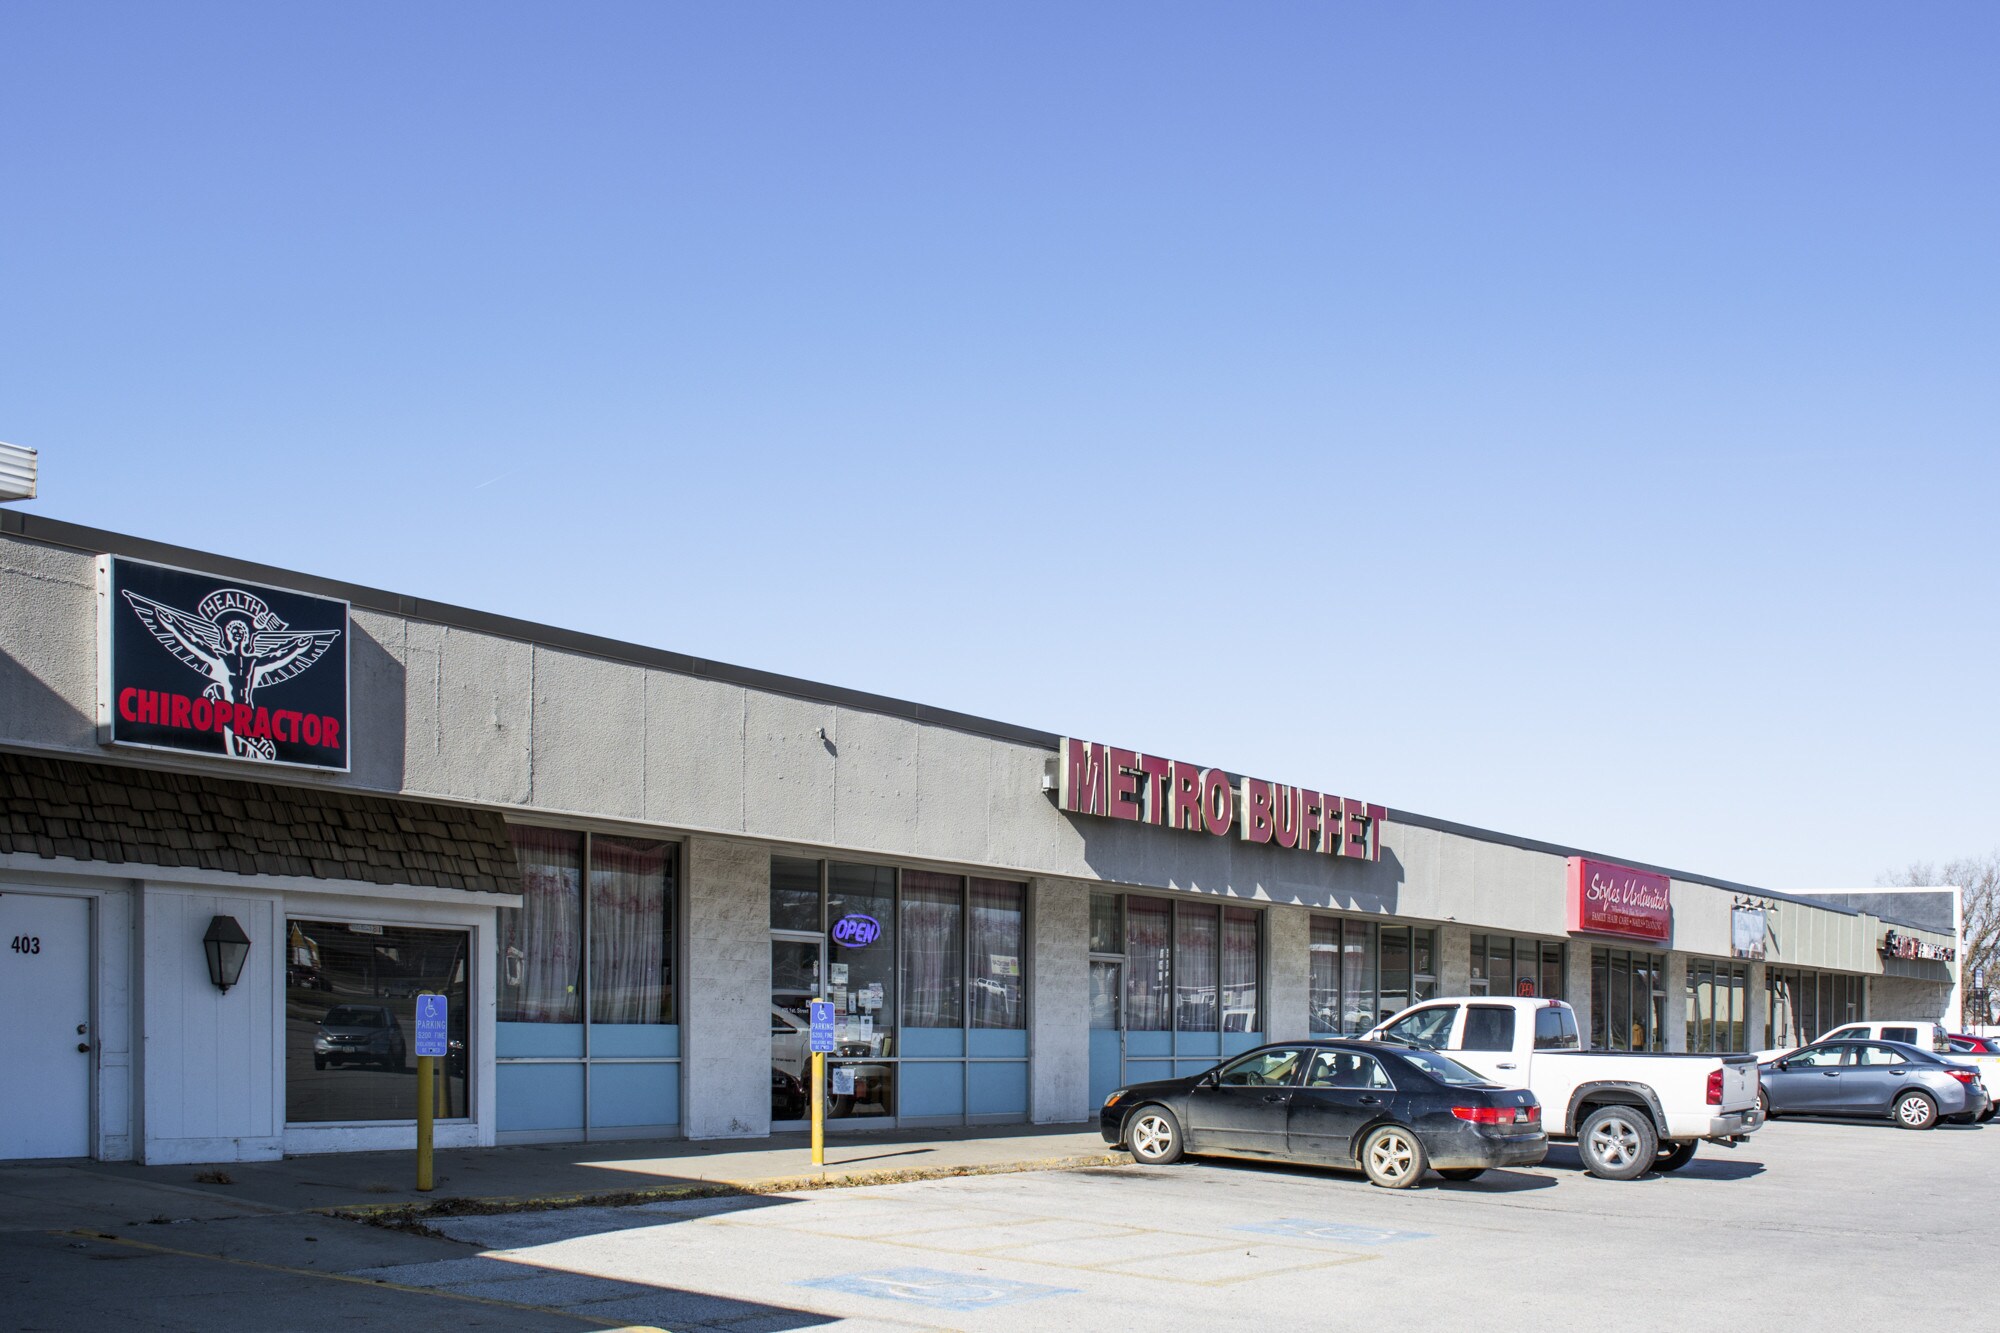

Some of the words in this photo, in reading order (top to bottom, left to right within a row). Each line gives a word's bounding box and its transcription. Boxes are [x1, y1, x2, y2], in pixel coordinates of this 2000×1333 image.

[203, 593, 262, 617] HEALTH
[119, 687, 340, 749] CHIROPRACTOR
[1060, 737, 1233, 836] METRO
[1241, 777, 1388, 862] BUFFET
[1586, 873, 1620, 912] Styles
[1623, 879, 1669, 911] Unlimited
[1607, 913, 1618, 924] HAIR
[1619, 915, 1629, 925] CARE
[835, 919, 876, 944] OPEN
[11, 935, 41, 955] 403
[1518, 982, 1535, 997] OPEN
[417, 1020, 446, 1030] PARKING
[812, 1023, 834, 1031] PARKING
[434, 1031, 446, 1040] FINE
